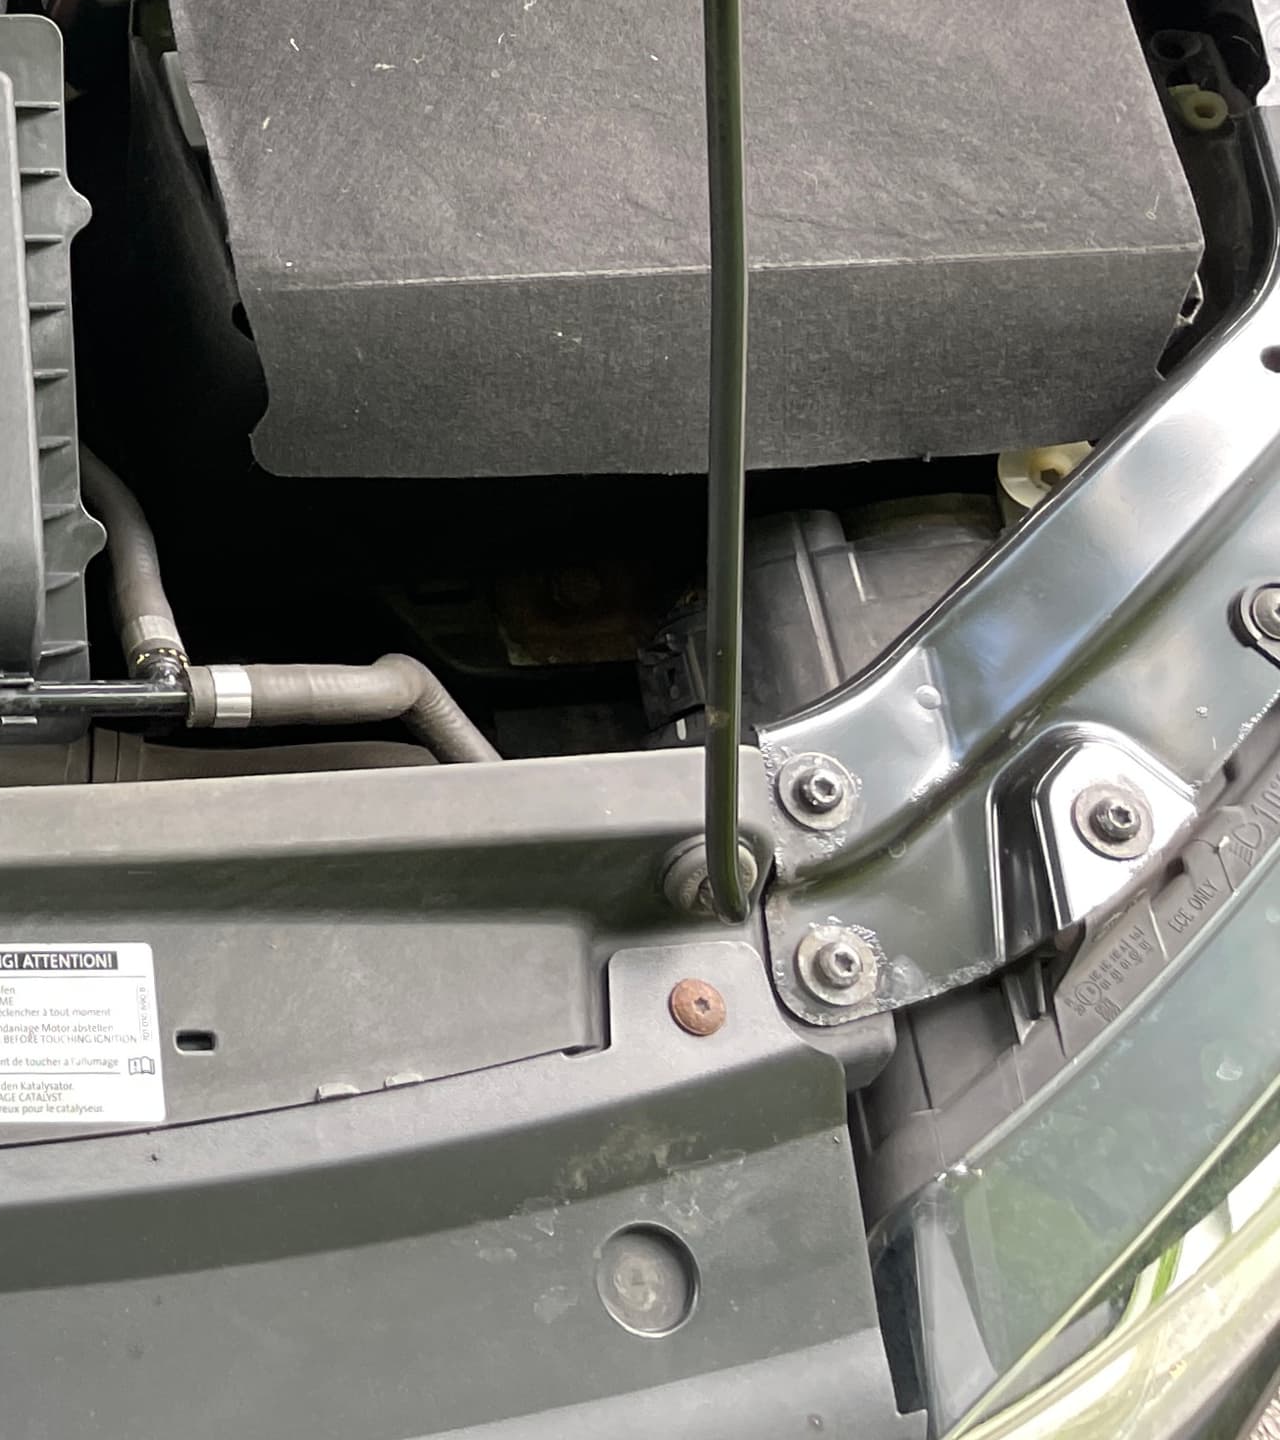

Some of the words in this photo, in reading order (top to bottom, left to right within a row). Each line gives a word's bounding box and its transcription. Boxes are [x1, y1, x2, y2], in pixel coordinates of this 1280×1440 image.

[1190, 879, 1219, 911] ONLY
[22, 953, 113, 968] ATTENTION!
[50, 1008, 70, 1016] tout
[72, 1008, 111, 1016] moment
[42, 1024, 70, 1032] Motor
[72, 1024, 114, 1032] abstellen
[4, 1034, 38, 1044] BEFORE
[38, 1034, 92, 1044] TOUCHING
[94, 1034, 138, 1044] IGNITION
[14, 1058, 24, 1066] de
[26, 1058, 62, 1066] toucher
[0, 1081, 18, 1090] den
[22, 1106, 43, 1115] pour
[46, 1105, 54, 1113] le
